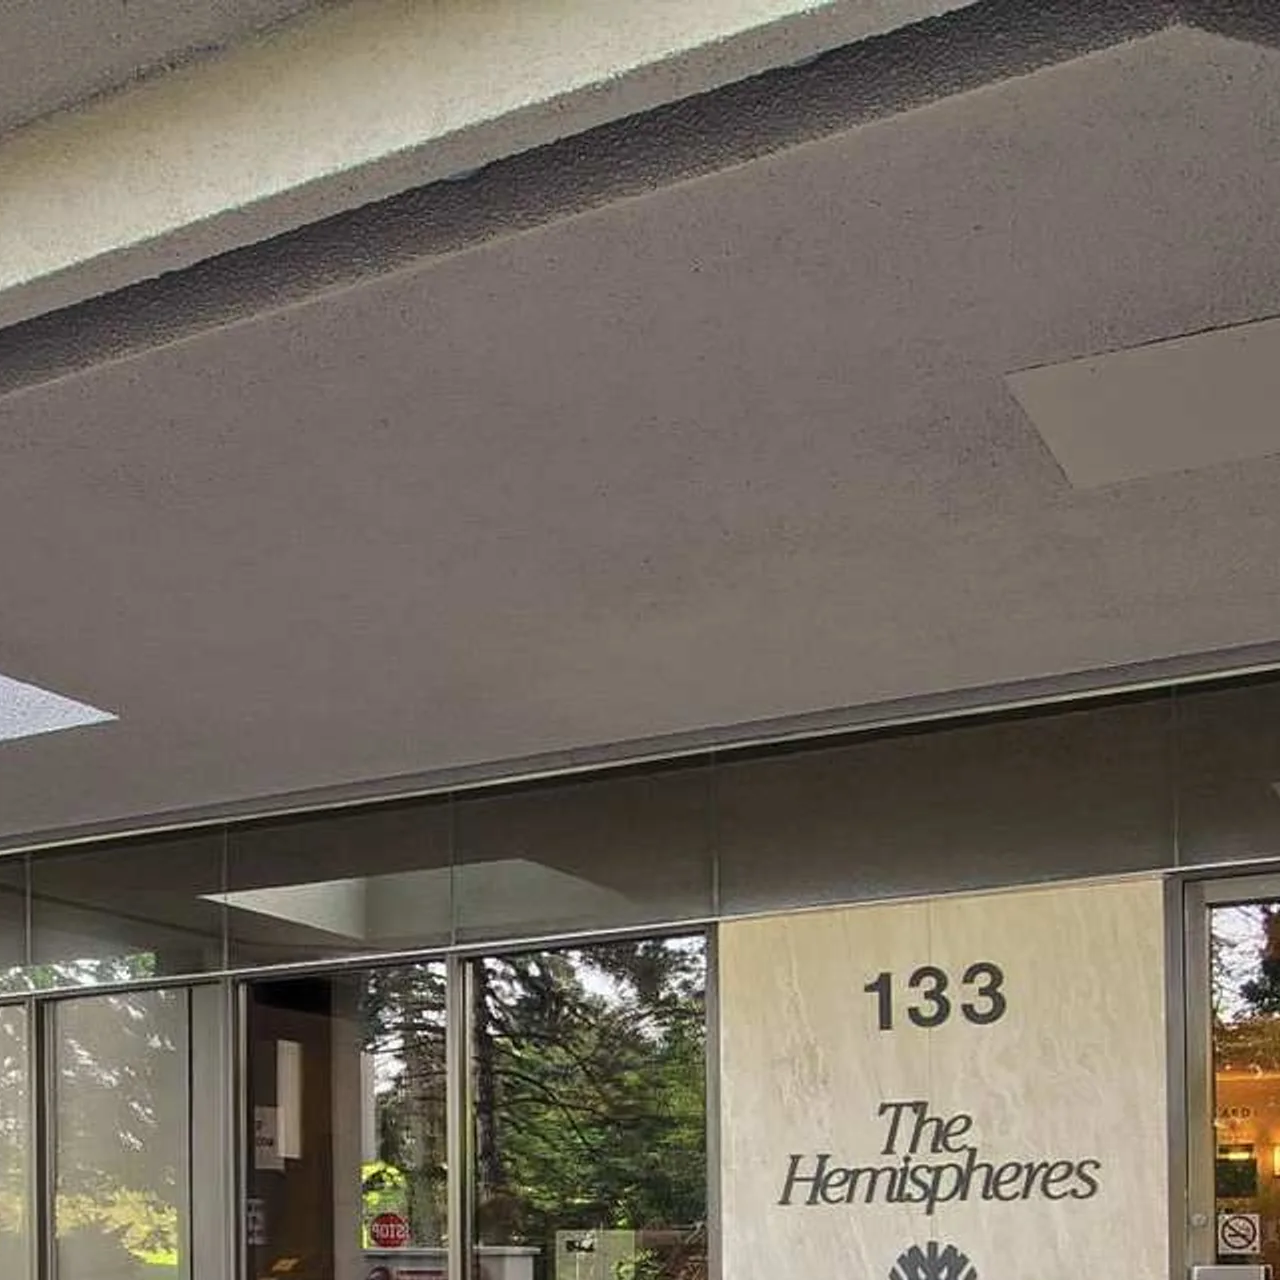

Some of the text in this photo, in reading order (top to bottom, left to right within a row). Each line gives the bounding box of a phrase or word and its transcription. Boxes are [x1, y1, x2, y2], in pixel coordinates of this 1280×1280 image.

[863, 962, 1007, 1030] 133
[878, 1101, 973, 1155] The
[778, 1147, 1102, 1216] Hemispheres
